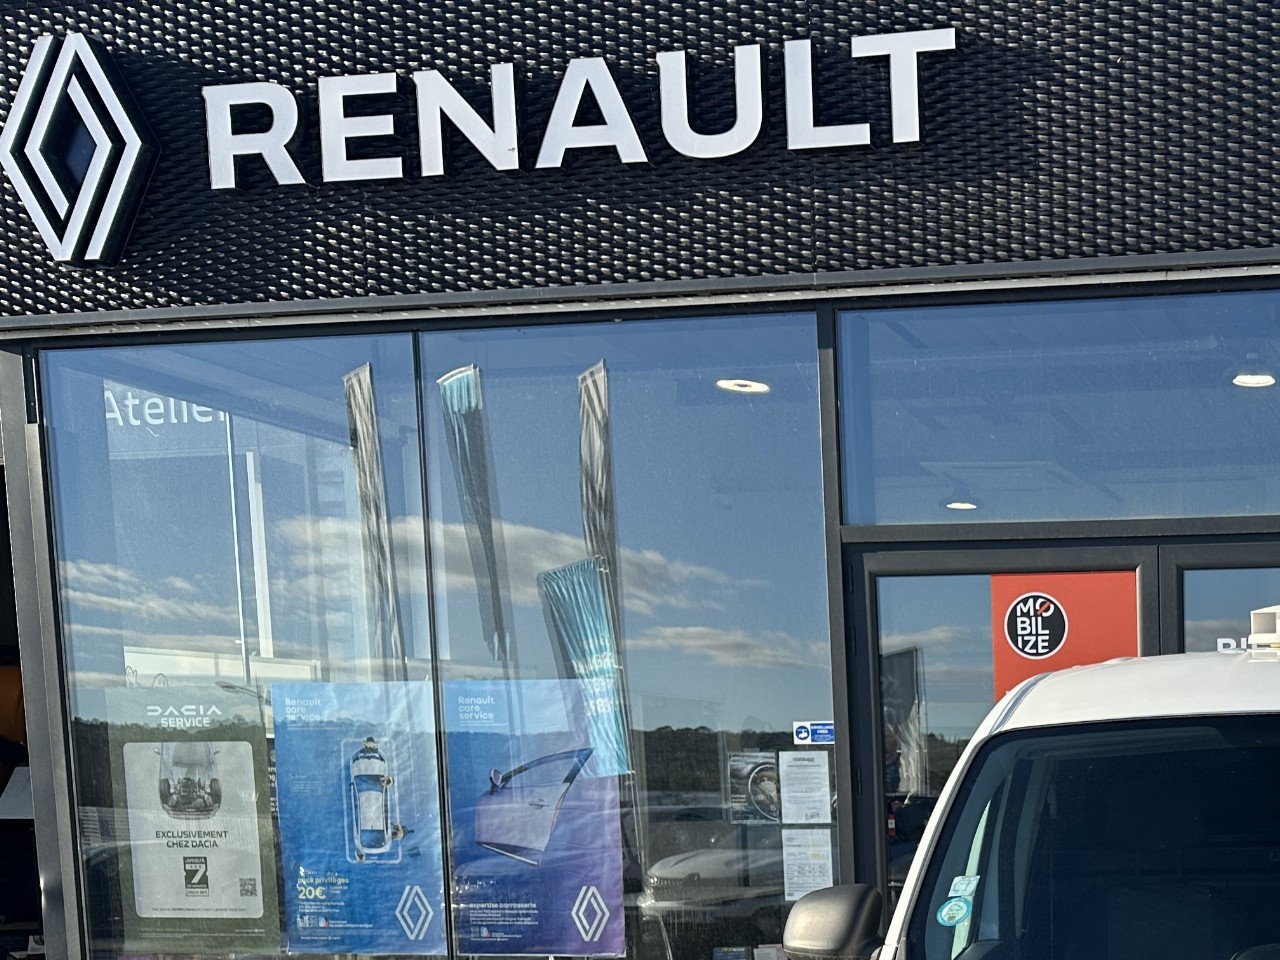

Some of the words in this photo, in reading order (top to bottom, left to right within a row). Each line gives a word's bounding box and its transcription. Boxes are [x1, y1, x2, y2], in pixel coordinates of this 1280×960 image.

[202, 26, 957, 190] RENAULT
[285, 698, 322, 706] Renault
[458, 696, 495, 704] Renault
[146, 705, 222, 715] DACIA
[459, 711, 494, 719] service
[161, 717, 210, 728] SERVICE
[155, 830, 228, 839] EXCLUSIVEMENT
[166, 840, 189, 848] CHEZ
[192, 840, 218, 848] DACIA
[298, 886, 326, 899] 20€
